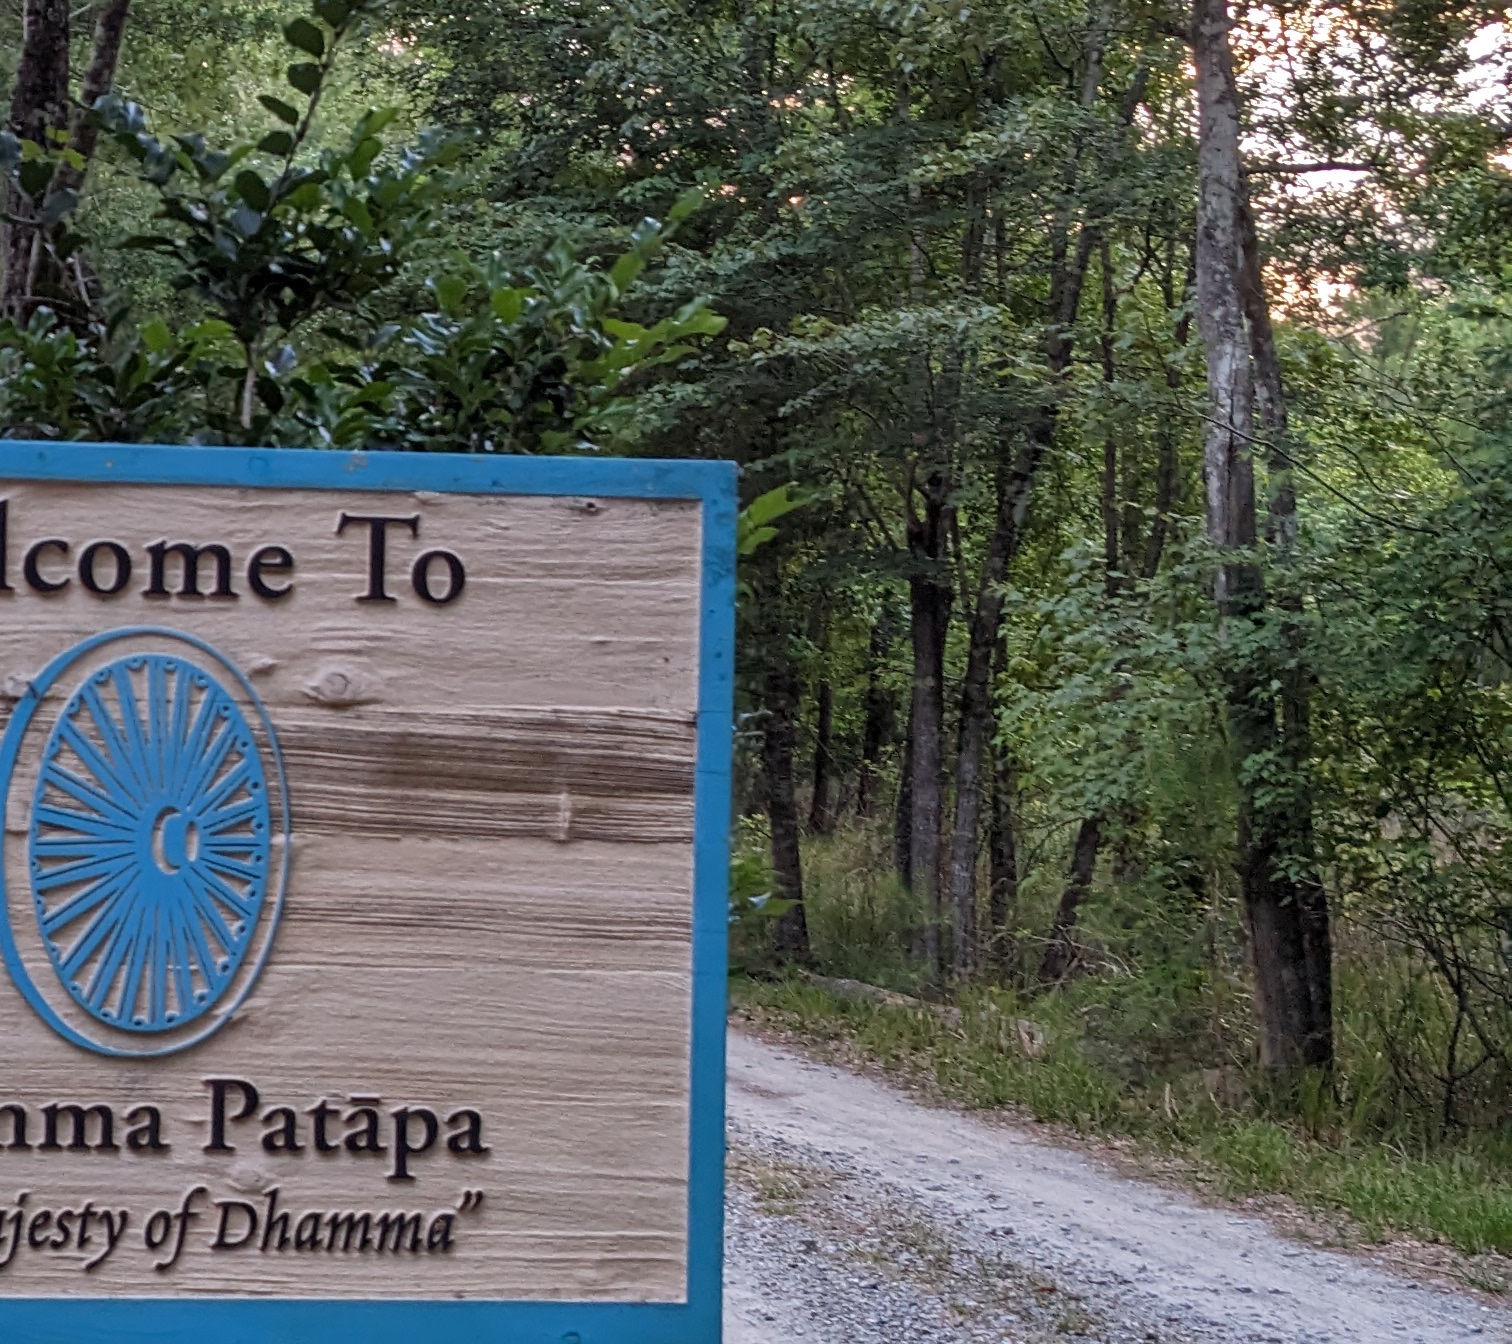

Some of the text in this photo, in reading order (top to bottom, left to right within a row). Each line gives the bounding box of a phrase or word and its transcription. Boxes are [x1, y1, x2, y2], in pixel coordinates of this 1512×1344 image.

[336, 511, 467, 606] To
[202, 1077, 490, 1181] Patāpa
[144, 1188, 210, 1272] of
[211, 1190, 484, 1256] Dhamma”
